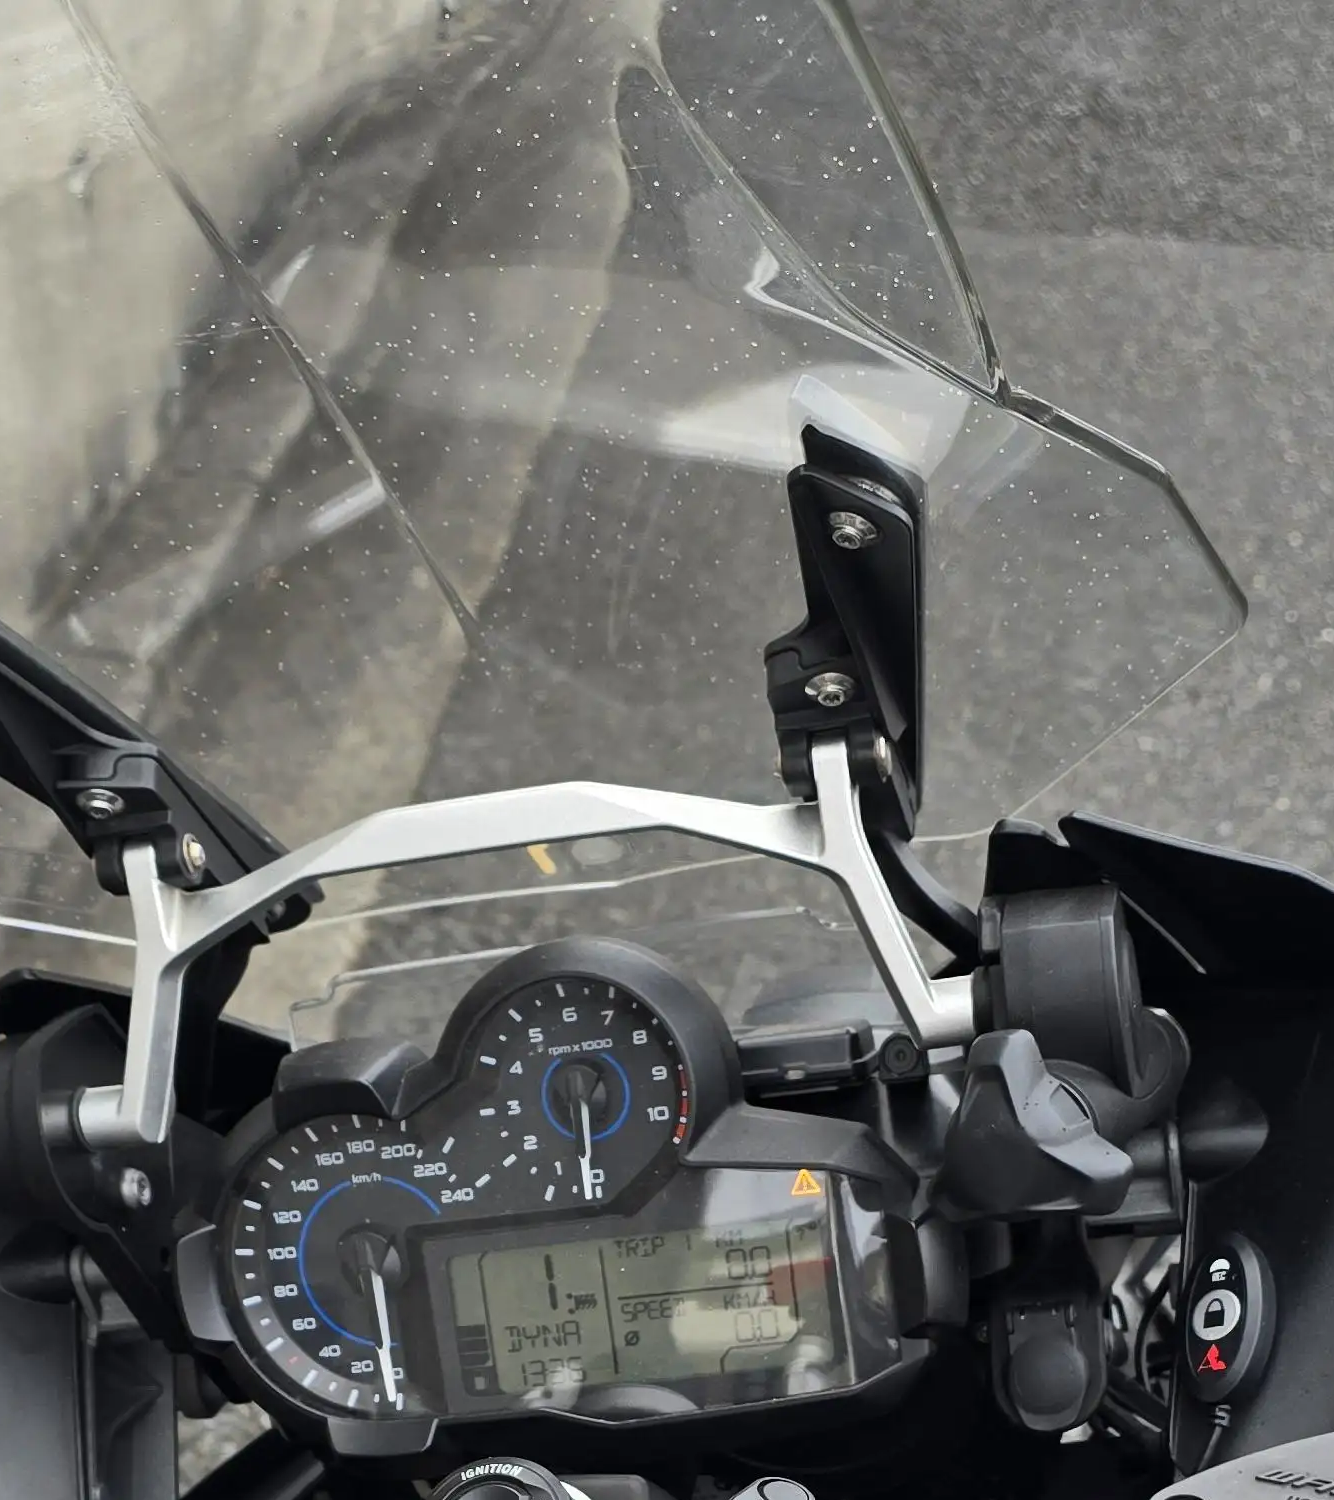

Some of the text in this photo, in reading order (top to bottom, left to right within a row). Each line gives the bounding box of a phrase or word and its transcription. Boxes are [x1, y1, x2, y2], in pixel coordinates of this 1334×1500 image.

[562, 1006, 578, 1022] 6
[601, 1010, 615, 1026] 7
[528, 1027, 544, 1043] 5
[632, 1029, 648, 1045] 8
[548, 1044, 571, 1056] rpm
[509, 1061, 523, 1075] 4
[651, 1065, 667, 1081] 9
[507, 1100, 521, 1116] 3
[647, 1105, 670, 1122] 10
[346, 1139, 375, 1154] 180
[523, 1135, 538, 1151] 2
[315, 1152, 344, 1167] 160
[381, 1144, 416, 1160] 200
[414, 1162, 447, 1177] 220
[555, 1161, 563, 1175] 1
[351, 1172, 382, 1185] km/h
[590, 1169, 605, 1183] 0
[291, 1178, 319, 1192] 140
[441, 1188, 474, 1204] 240
[273, 1210, 302, 1224] 120
[267, 1246, 297, 1261] 100
[614, 1236, 665, 1257] TRIP
[273, 1283, 298, 1298] 80
[292, 1317, 317, 1331] 60
[505, 1320, 582, 1353] DYNA
[318, 1345, 341, 1357] 40
[350, 1360, 374, 1373] 20
[392, 1368, 404, 1380] 0
[461, 1463, 523, 1481] IGNITION
